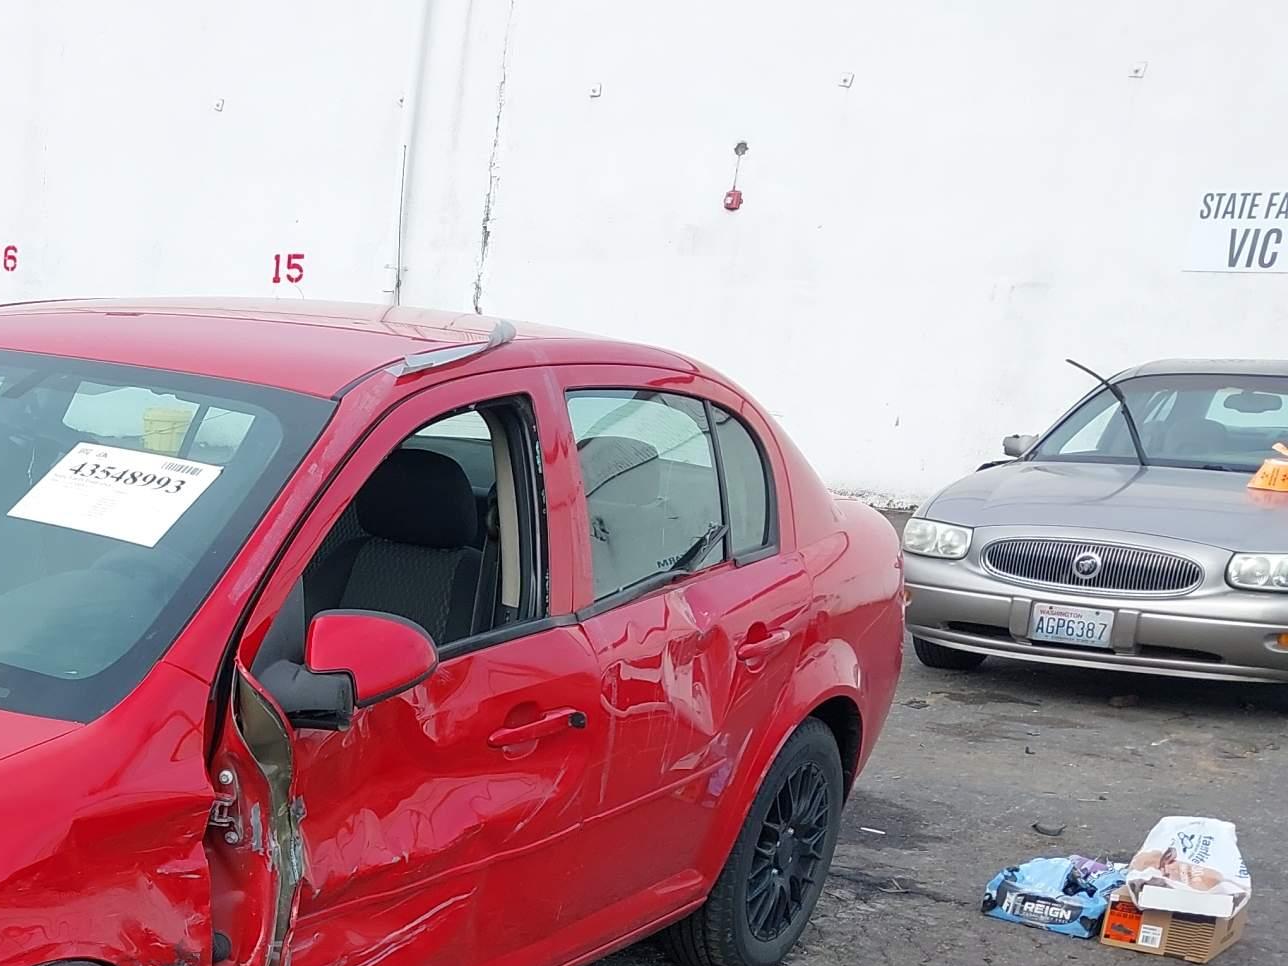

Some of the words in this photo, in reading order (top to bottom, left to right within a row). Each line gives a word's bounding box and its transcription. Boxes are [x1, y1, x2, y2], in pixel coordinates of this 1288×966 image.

[1200, 192, 1262, 220] STATE
[1227, 227, 1283, 269] VIC
[271, 251, 306, 285] 15
[69, 460, 187, 494] 43548993
[1035, 616, 1108, 641] AGP6387
[1022, 901, 1073, 921] REIGN
